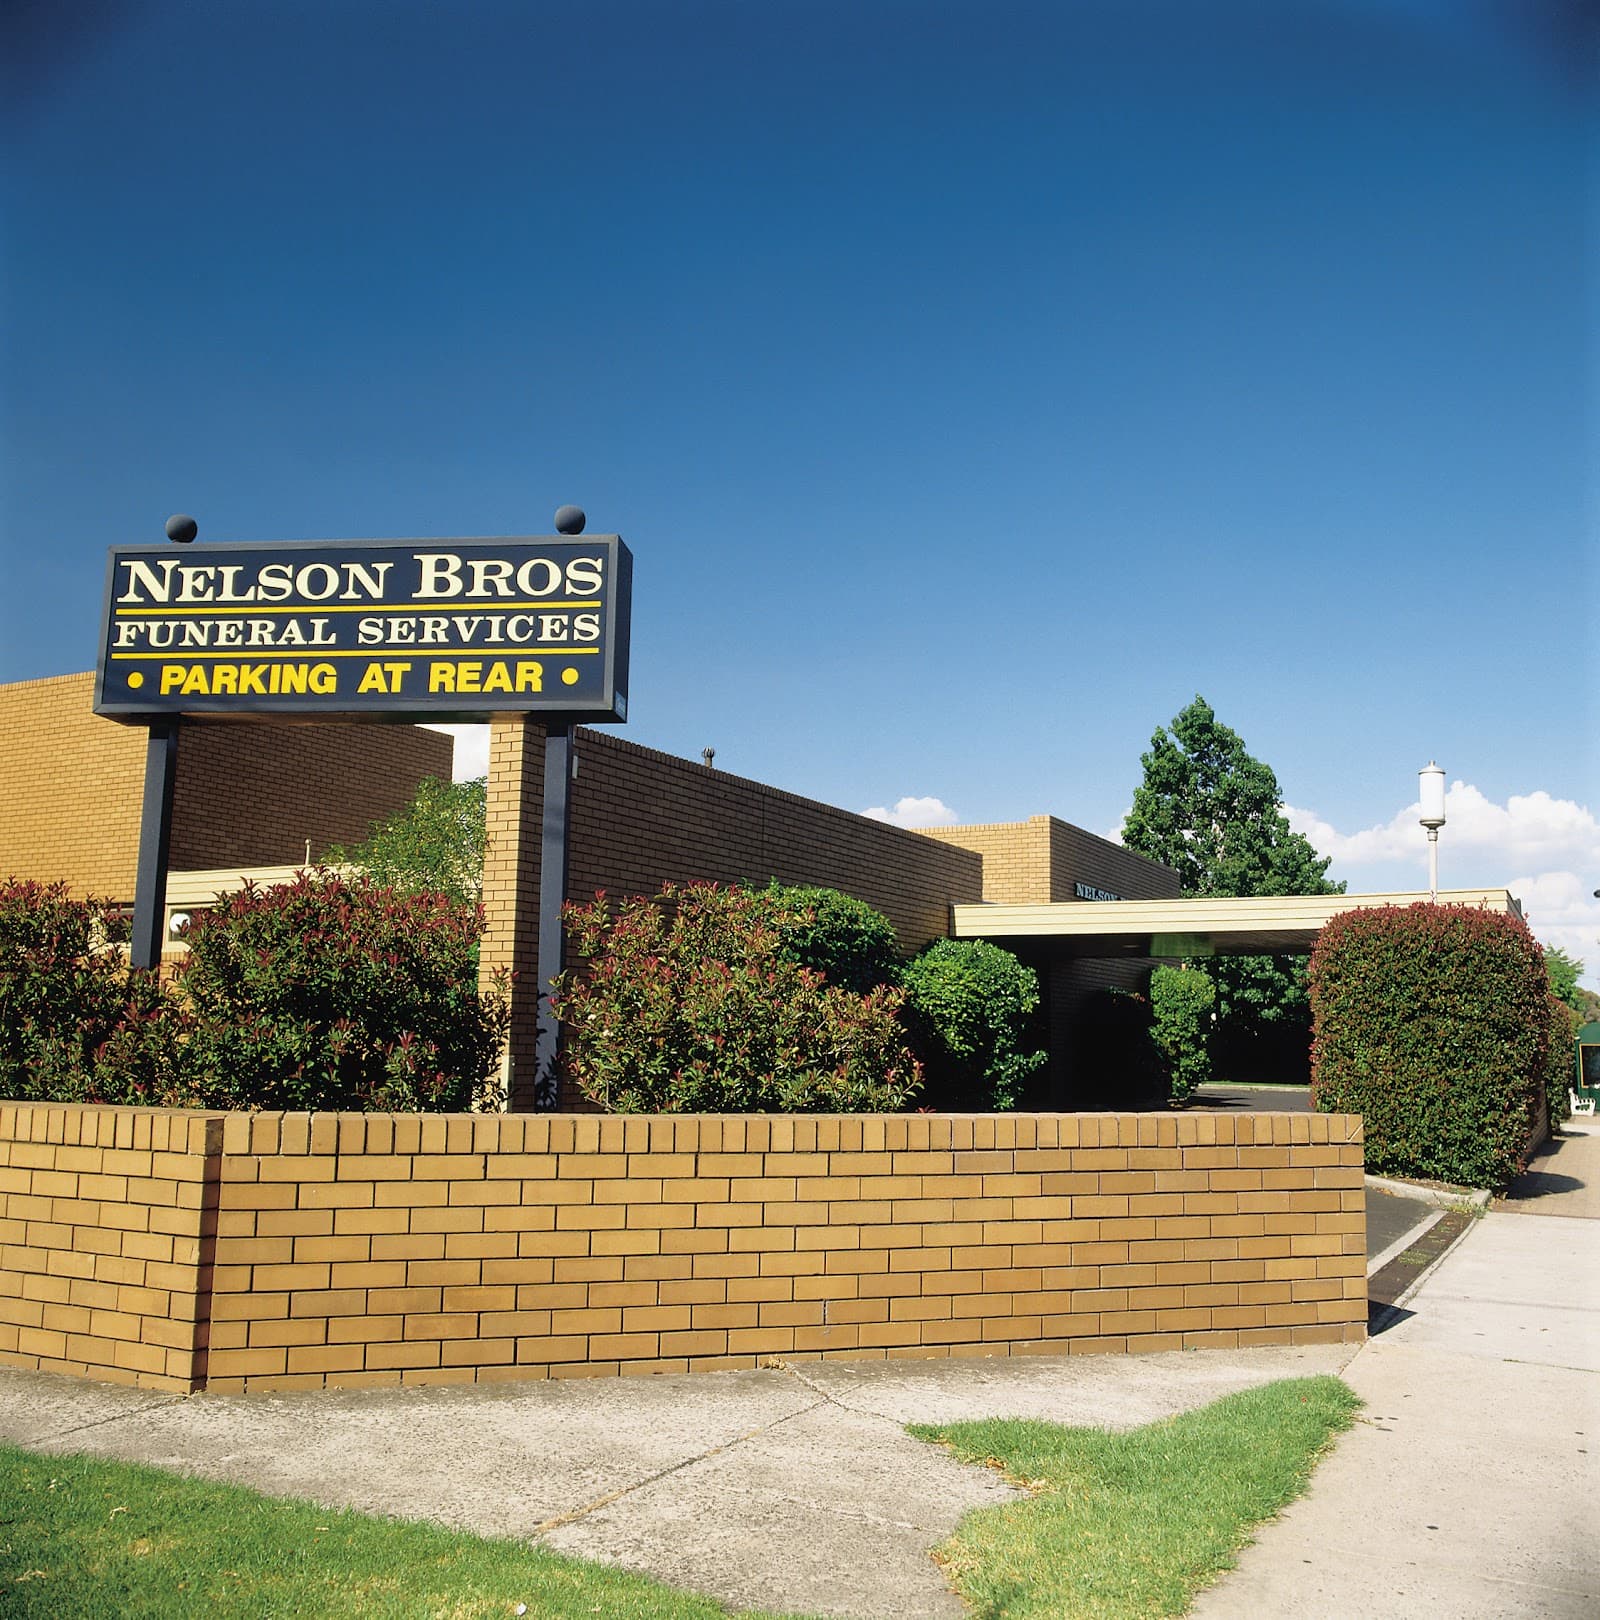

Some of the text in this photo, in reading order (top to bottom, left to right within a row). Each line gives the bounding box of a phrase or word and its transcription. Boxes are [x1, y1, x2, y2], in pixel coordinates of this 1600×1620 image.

[116, 554, 604, 603] NELSON BROS
[112, 613, 602, 648] FUNERAL SERVICES
[159, 660, 544, 696] PARKING AT REAR
